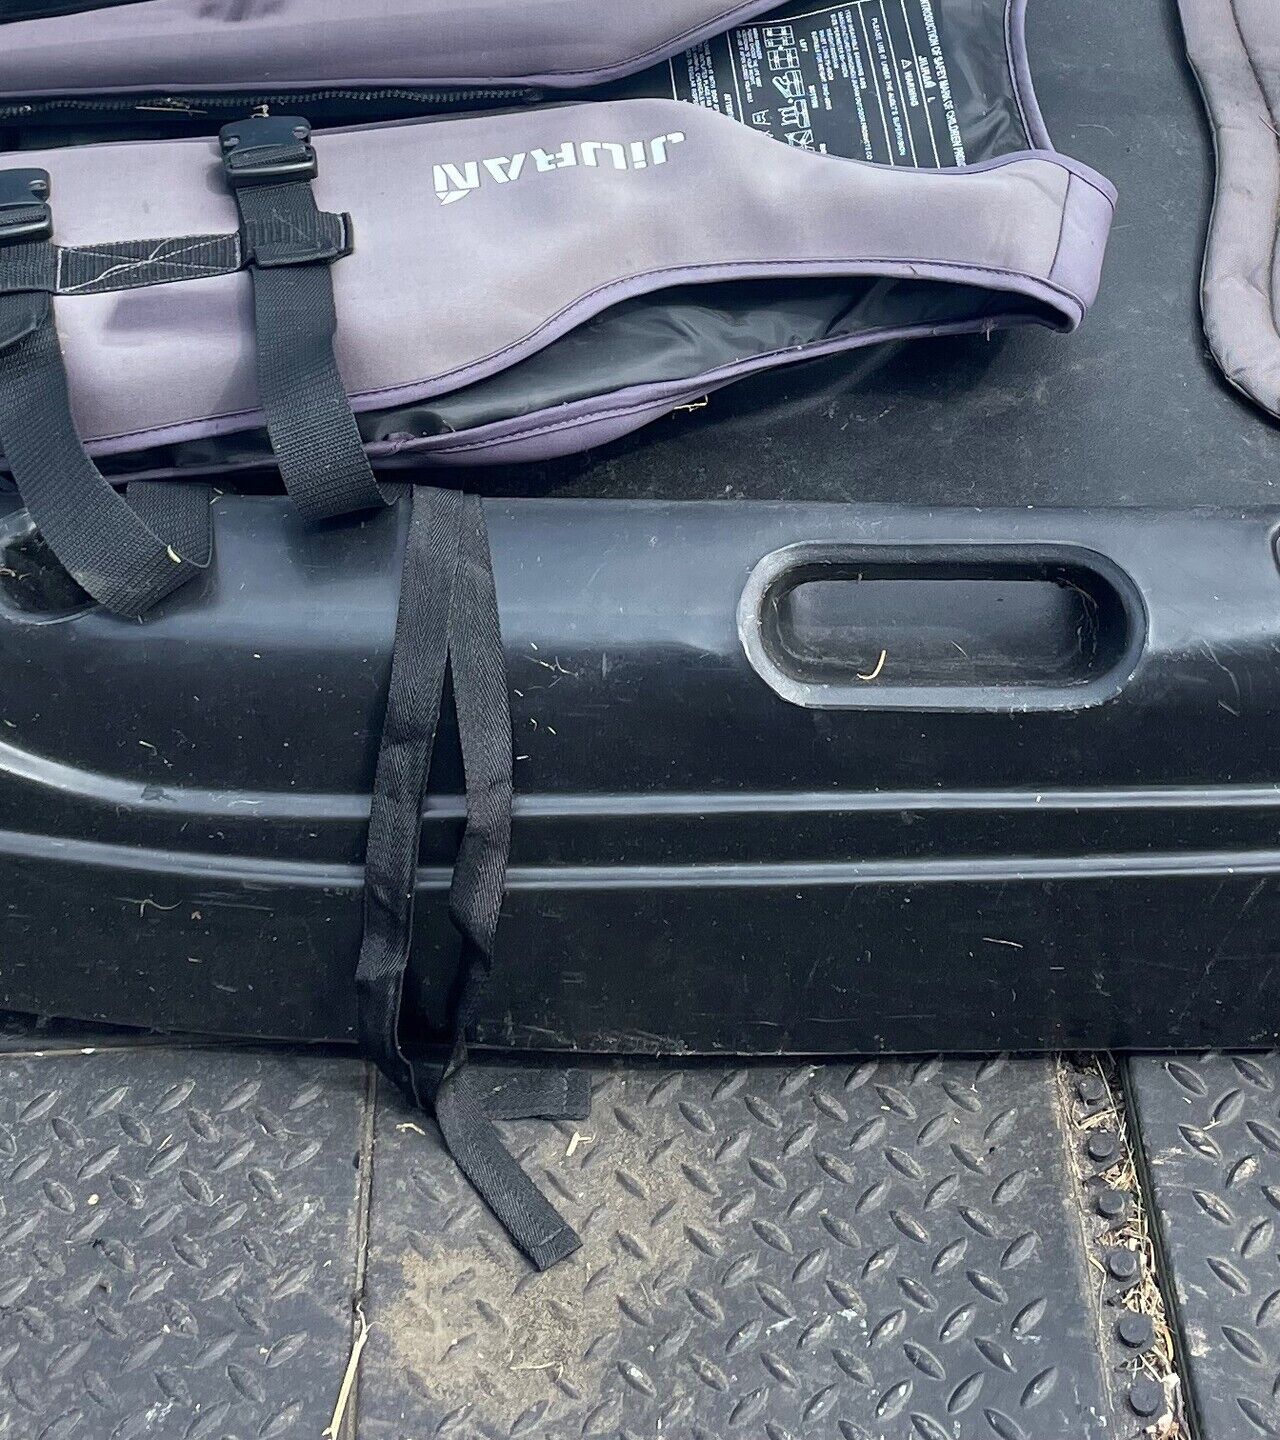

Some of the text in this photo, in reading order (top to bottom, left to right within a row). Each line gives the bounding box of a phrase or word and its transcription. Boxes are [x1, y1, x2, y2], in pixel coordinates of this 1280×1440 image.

[931, 46, 941, 56] OF
[872, 18, 881, 40] PLEASE
[893, 116, 905, 155] SUPERVISION
[904, 71, 918, 106] WARNING
[939, 80, 951, 101] MARK
[943, 100, 954, 110] OF
[946, 110, 961, 146] CHILDREN
